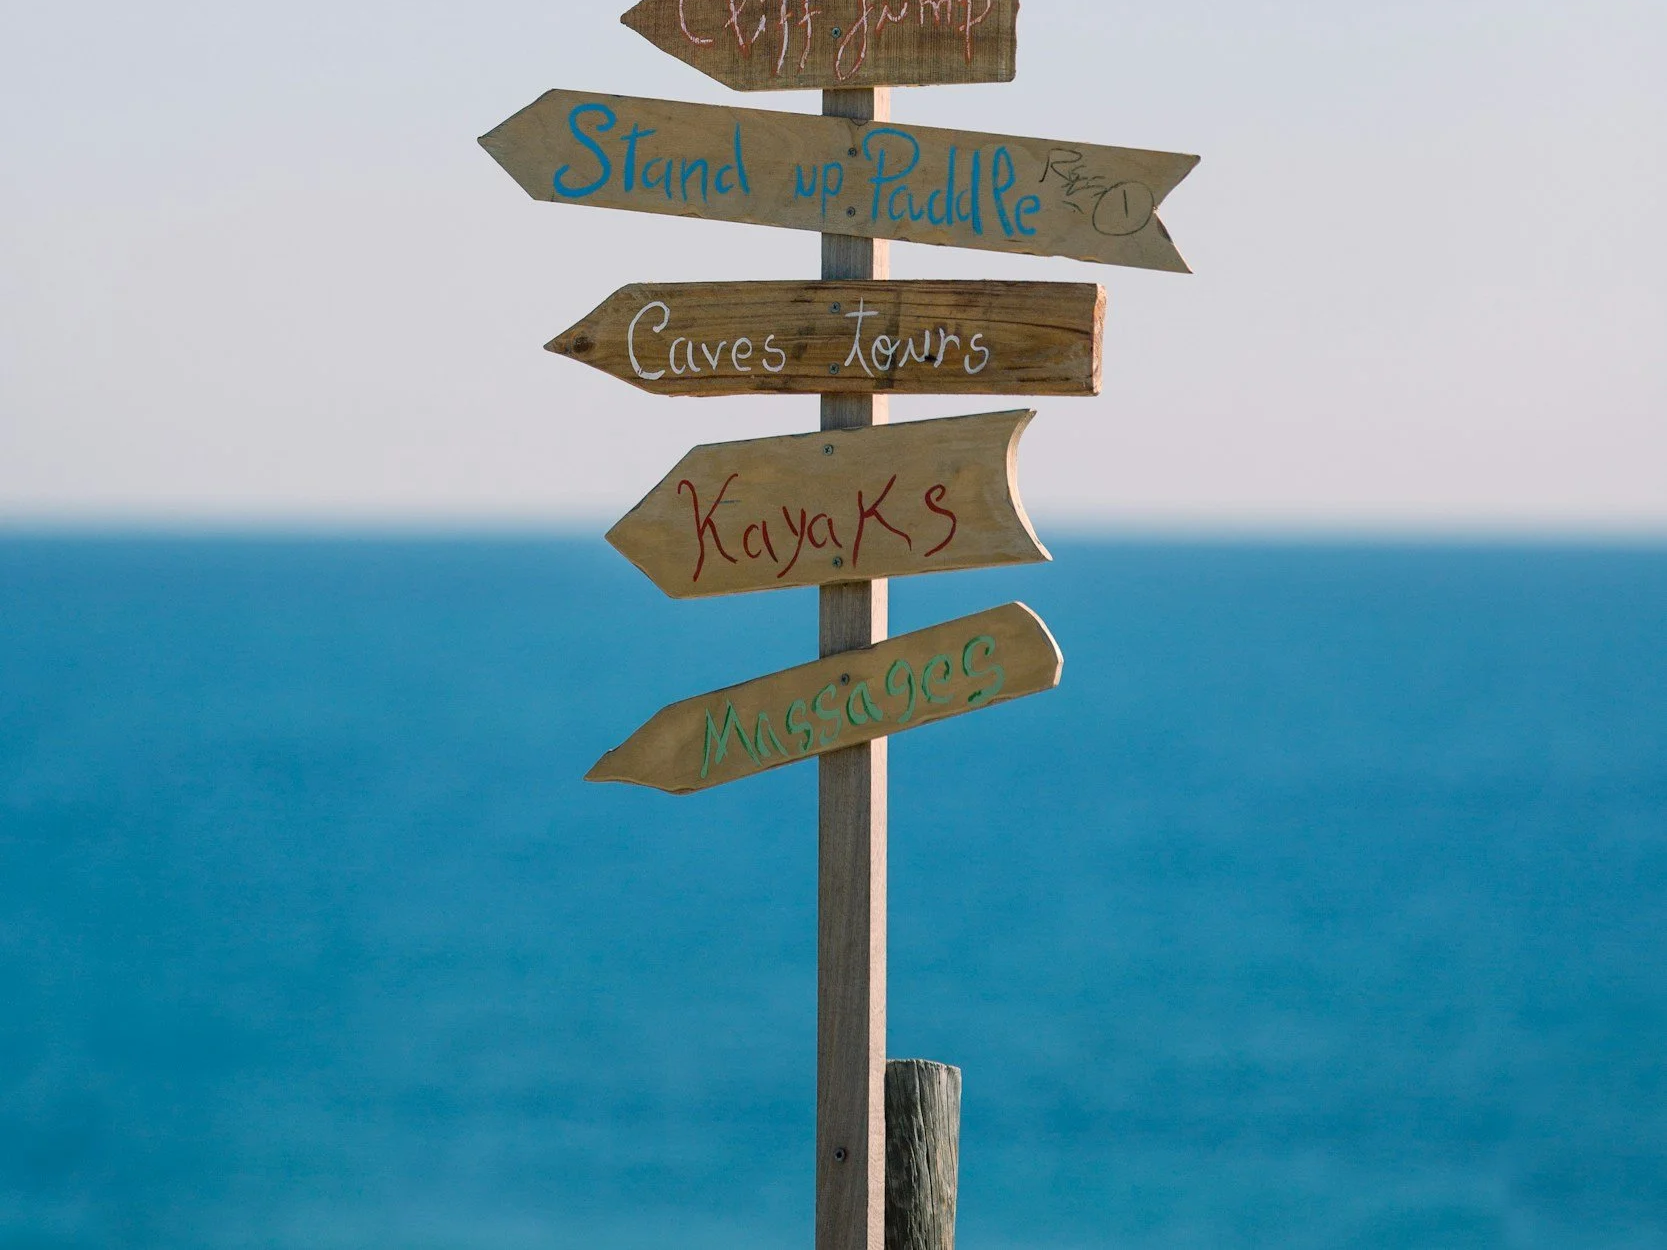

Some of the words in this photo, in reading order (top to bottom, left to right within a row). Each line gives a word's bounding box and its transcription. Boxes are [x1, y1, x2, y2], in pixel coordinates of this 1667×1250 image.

[553, 103, 750, 199] Stand
[793, 161, 842, 216] up
[861, 128, 1041, 237] Paddle
[627, 300, 787, 380] Caves
[843, 297, 989, 377] tours
[700, 636, 1004, 779] Massages
